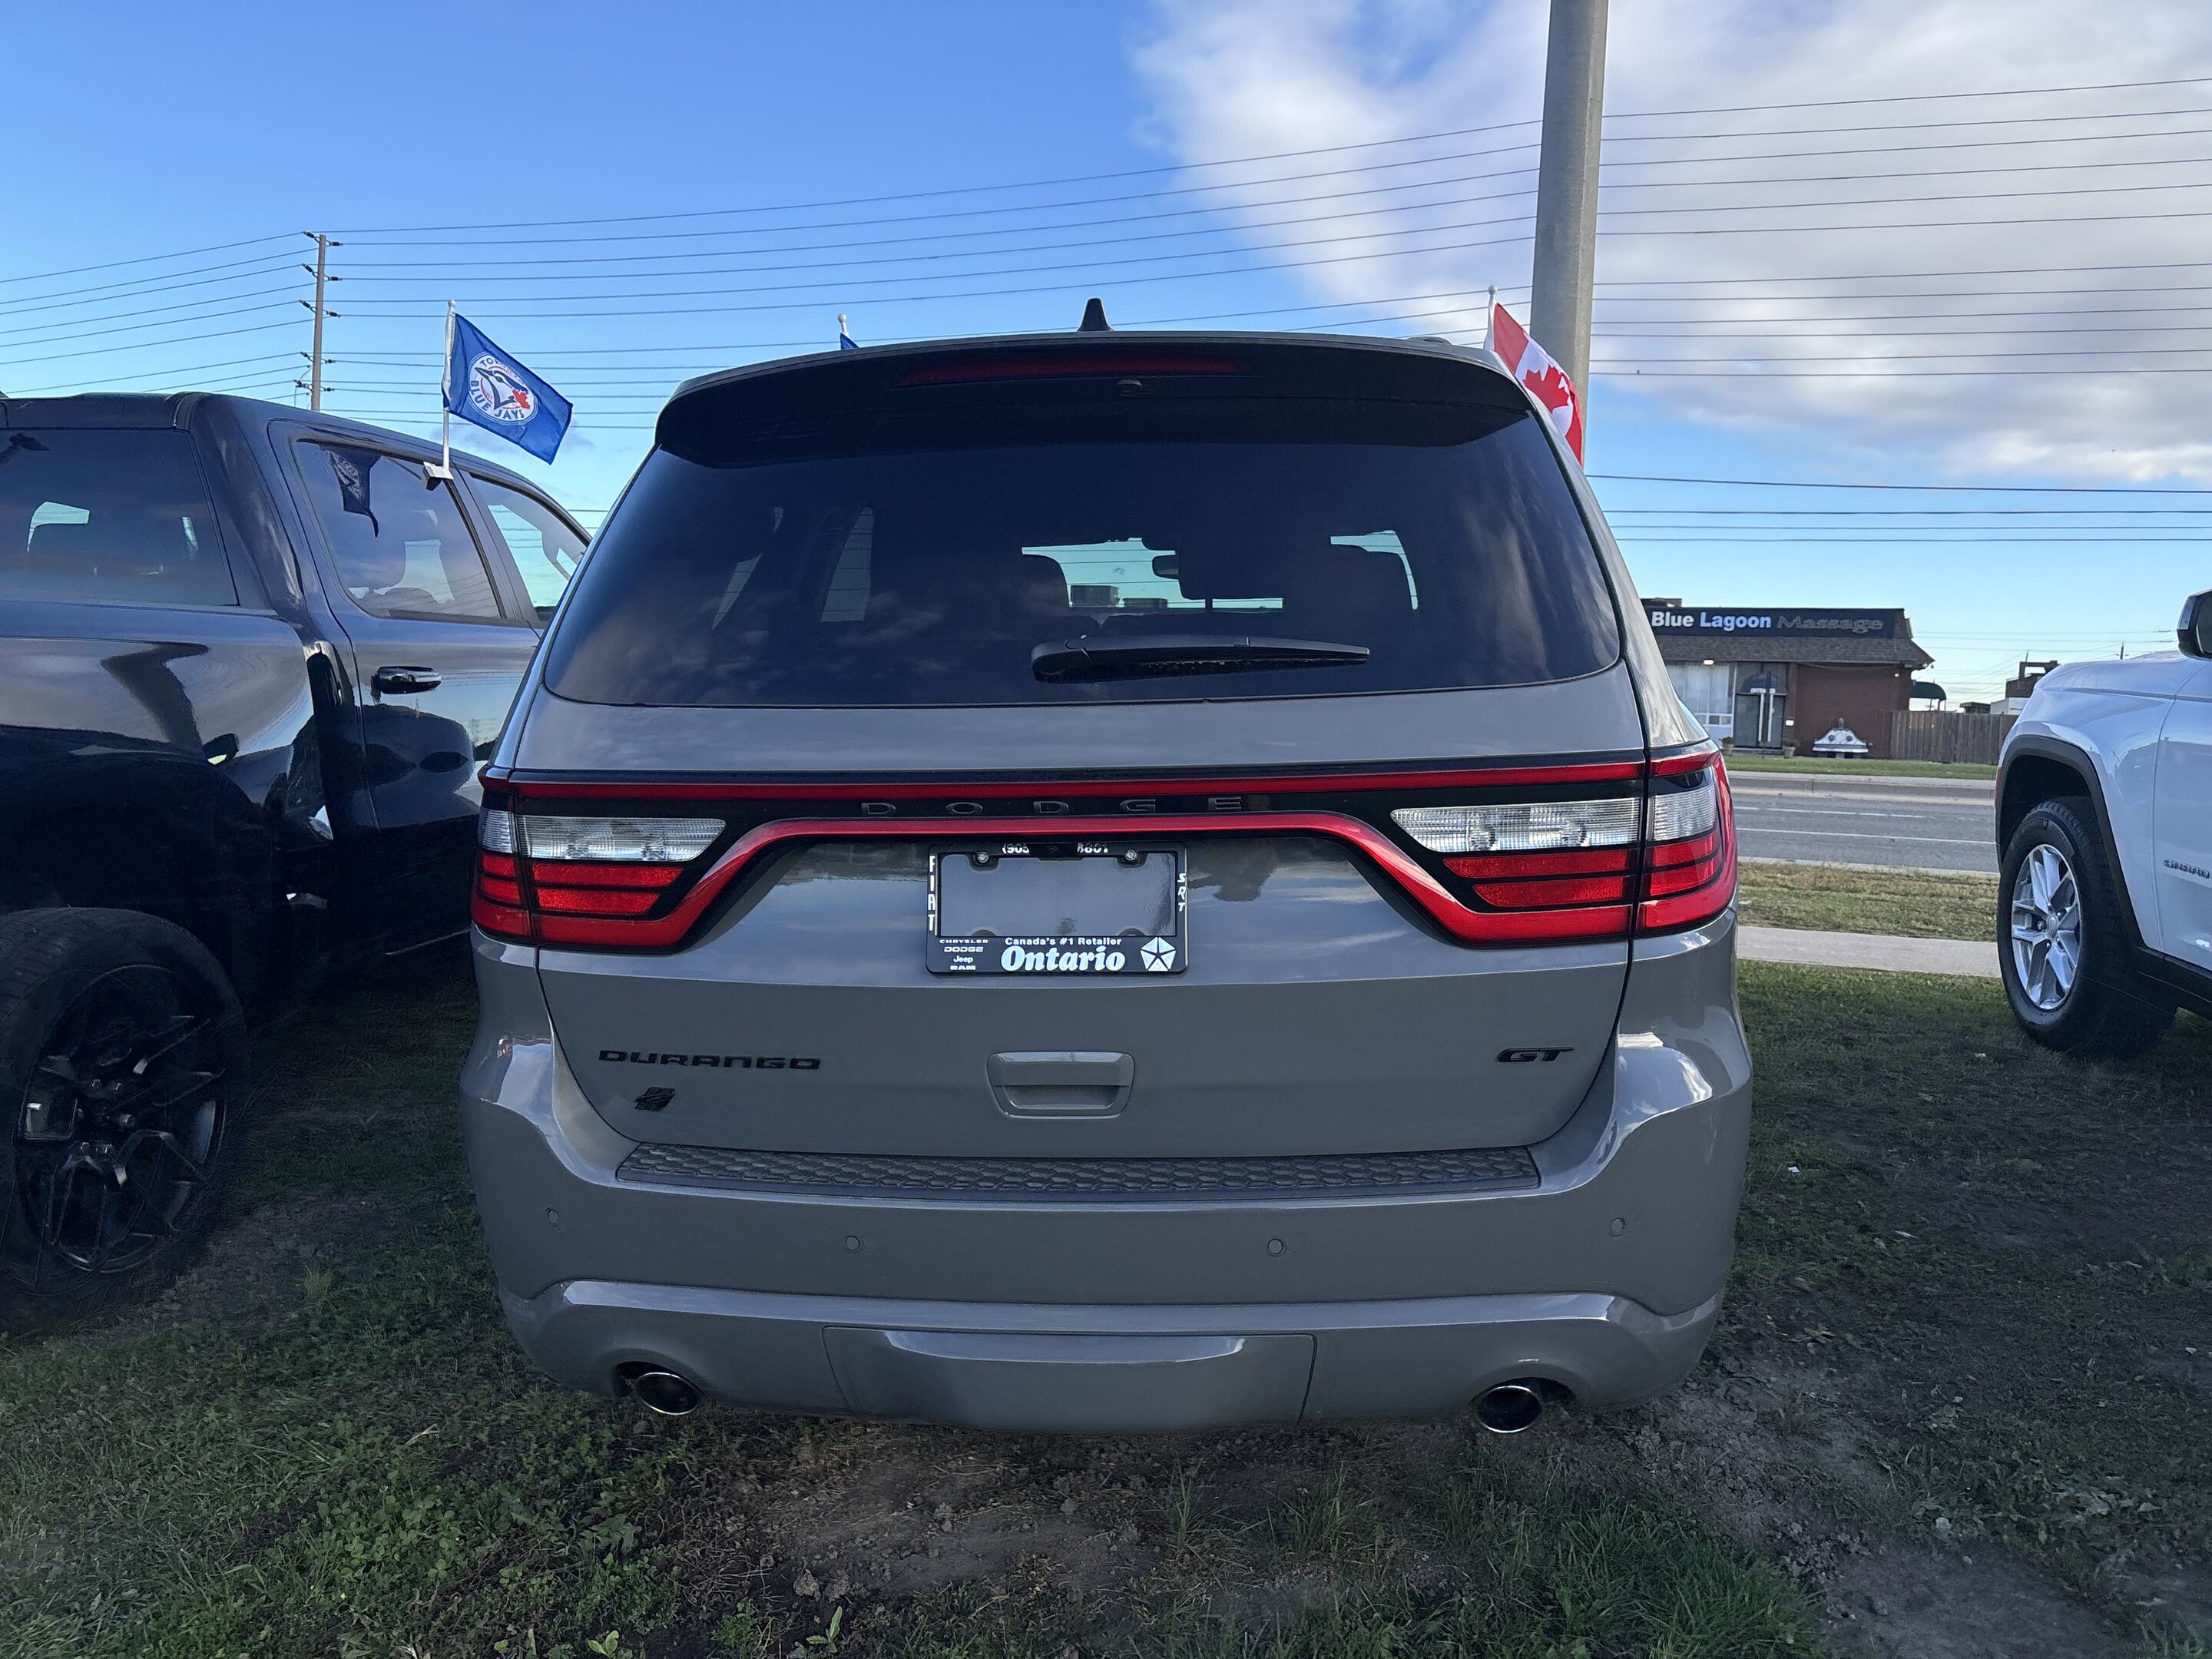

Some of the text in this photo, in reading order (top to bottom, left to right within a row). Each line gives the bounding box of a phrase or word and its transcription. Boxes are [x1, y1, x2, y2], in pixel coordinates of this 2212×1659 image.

[470, 380, 492, 411] BLUE
[494, 409, 525, 420] JAYS
[1651, 611, 1884, 633] Blue Lagoon Massage
[861, 796, 1242, 816] DODGE
[1177, 873, 1187, 912] SRT
[1005, 937, 1122, 945] Canada's #1 Retailer
[953, 955, 974, 964] Jeep
[1001, 945, 1126, 972] Ontario
[599, 1049, 822, 1070] DURANGO
[1498, 1047, 1575, 1063] GT
